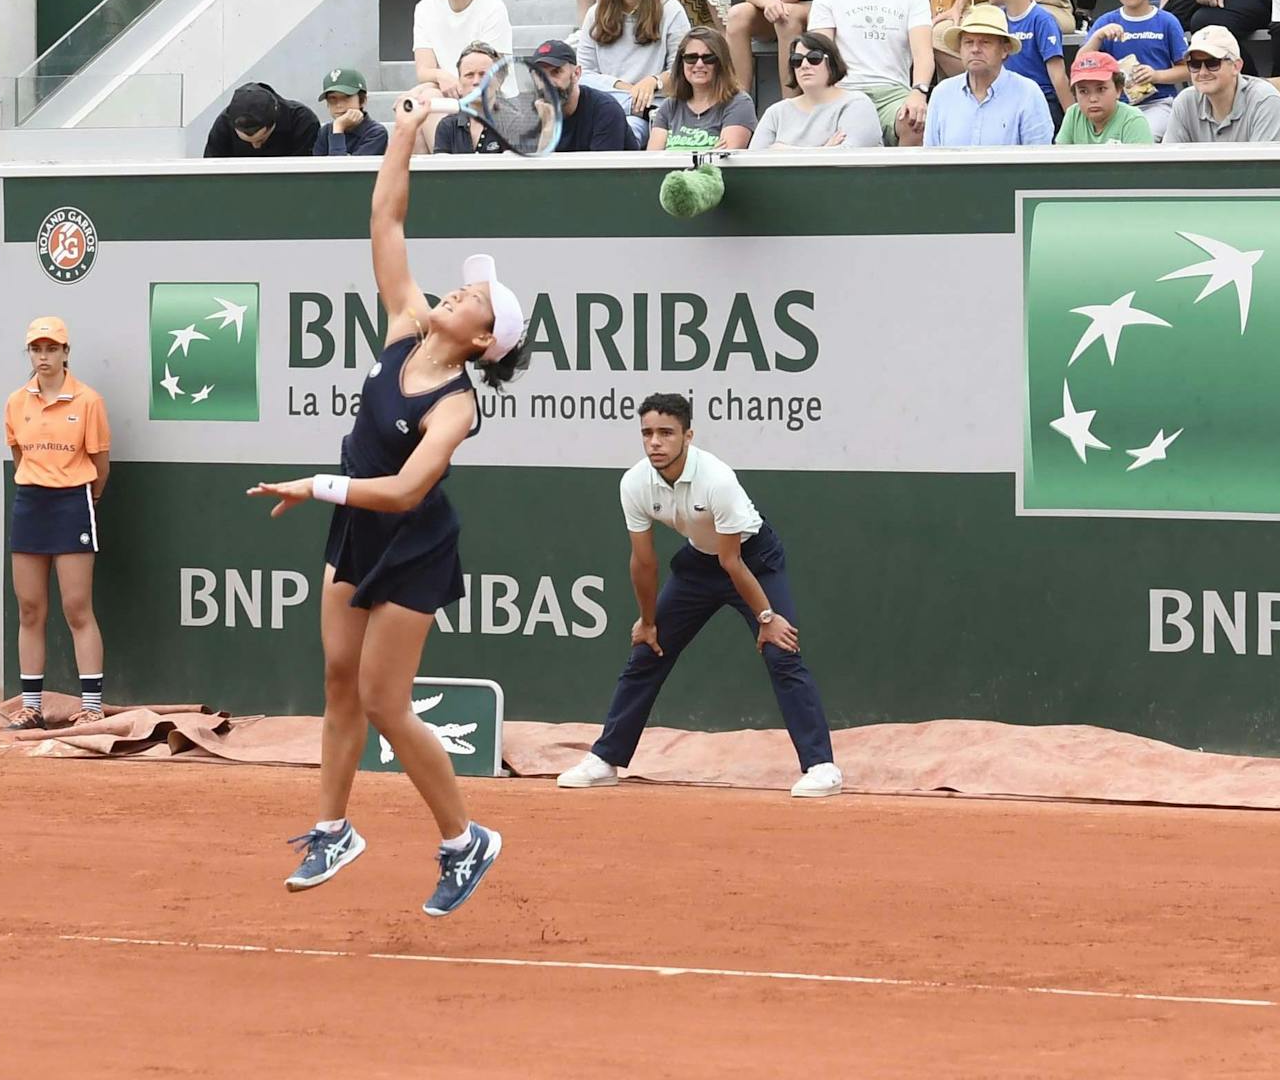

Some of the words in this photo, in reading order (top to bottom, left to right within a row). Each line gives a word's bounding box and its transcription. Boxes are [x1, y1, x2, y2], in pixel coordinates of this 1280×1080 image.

[863, 31, 887, 41] 1932
[40, 211, 65, 255] ROLAND
[68, 211, 95, 253] GARROS
[49, 263, 87, 279] PARIS
[474, 290, 819, 373] ARIBAS
[288, 386, 320, 416] La
[531, 388, 635, 420] monde
[708, 388, 823, 432] change
[36, 442, 76, 453] PARIBAS
[180, 567, 310, 629] BNP
